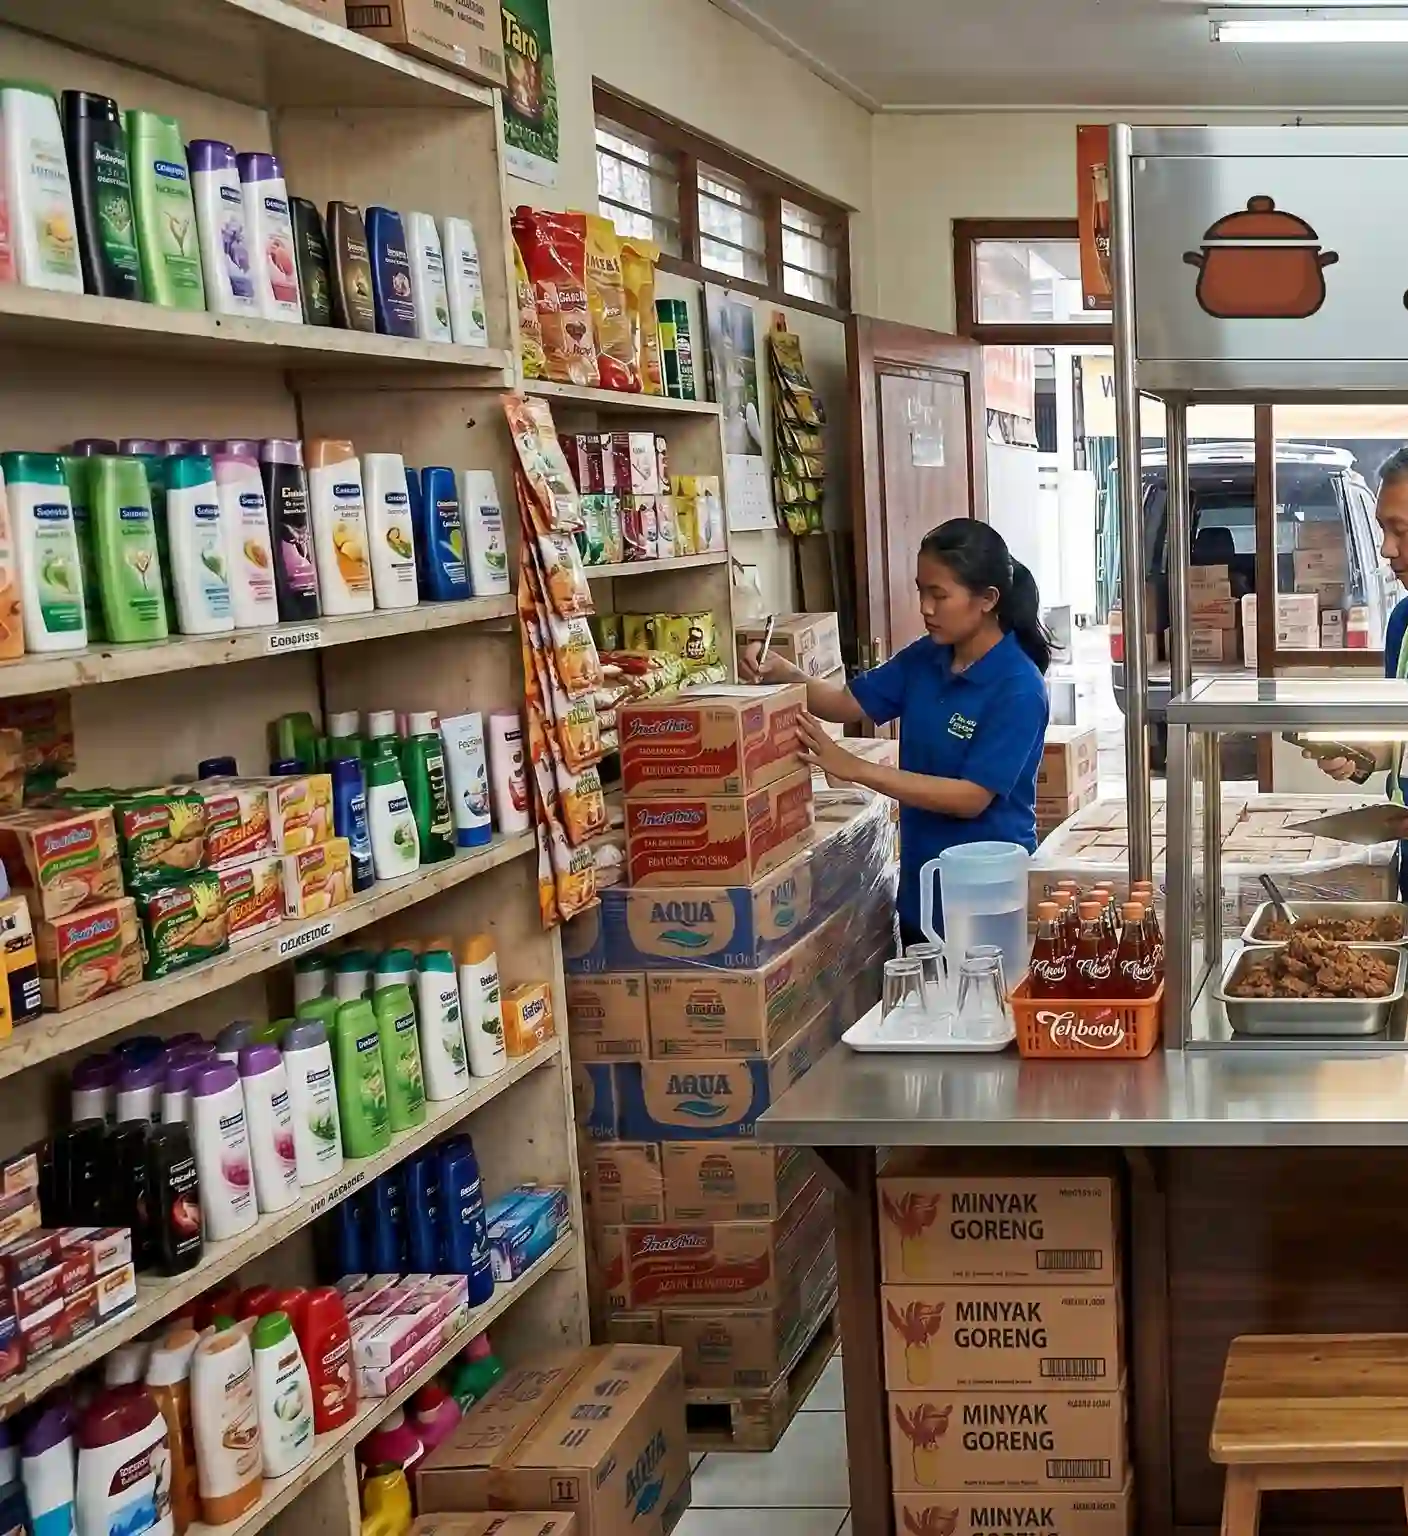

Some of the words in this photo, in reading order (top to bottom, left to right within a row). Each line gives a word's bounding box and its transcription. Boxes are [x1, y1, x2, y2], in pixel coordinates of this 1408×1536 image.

[502, 8, 539, 62] Taro
[650, 901, 716, 927] AQUA
[666, 1073, 733, 1098] AQUA
[951, 1193, 1038, 1213] MINYAK
[950, 1219, 1044, 1241] GORENG
[955, 1301, 1042, 1323] MINYAK
[954, 1328, 1047, 1350] GORENG
[963, 1404, 1048, 1425] MINYAK
[962, 1431, 1054, 1451] GORENG
[969, 1507, 1054, 1527] MINYAK
